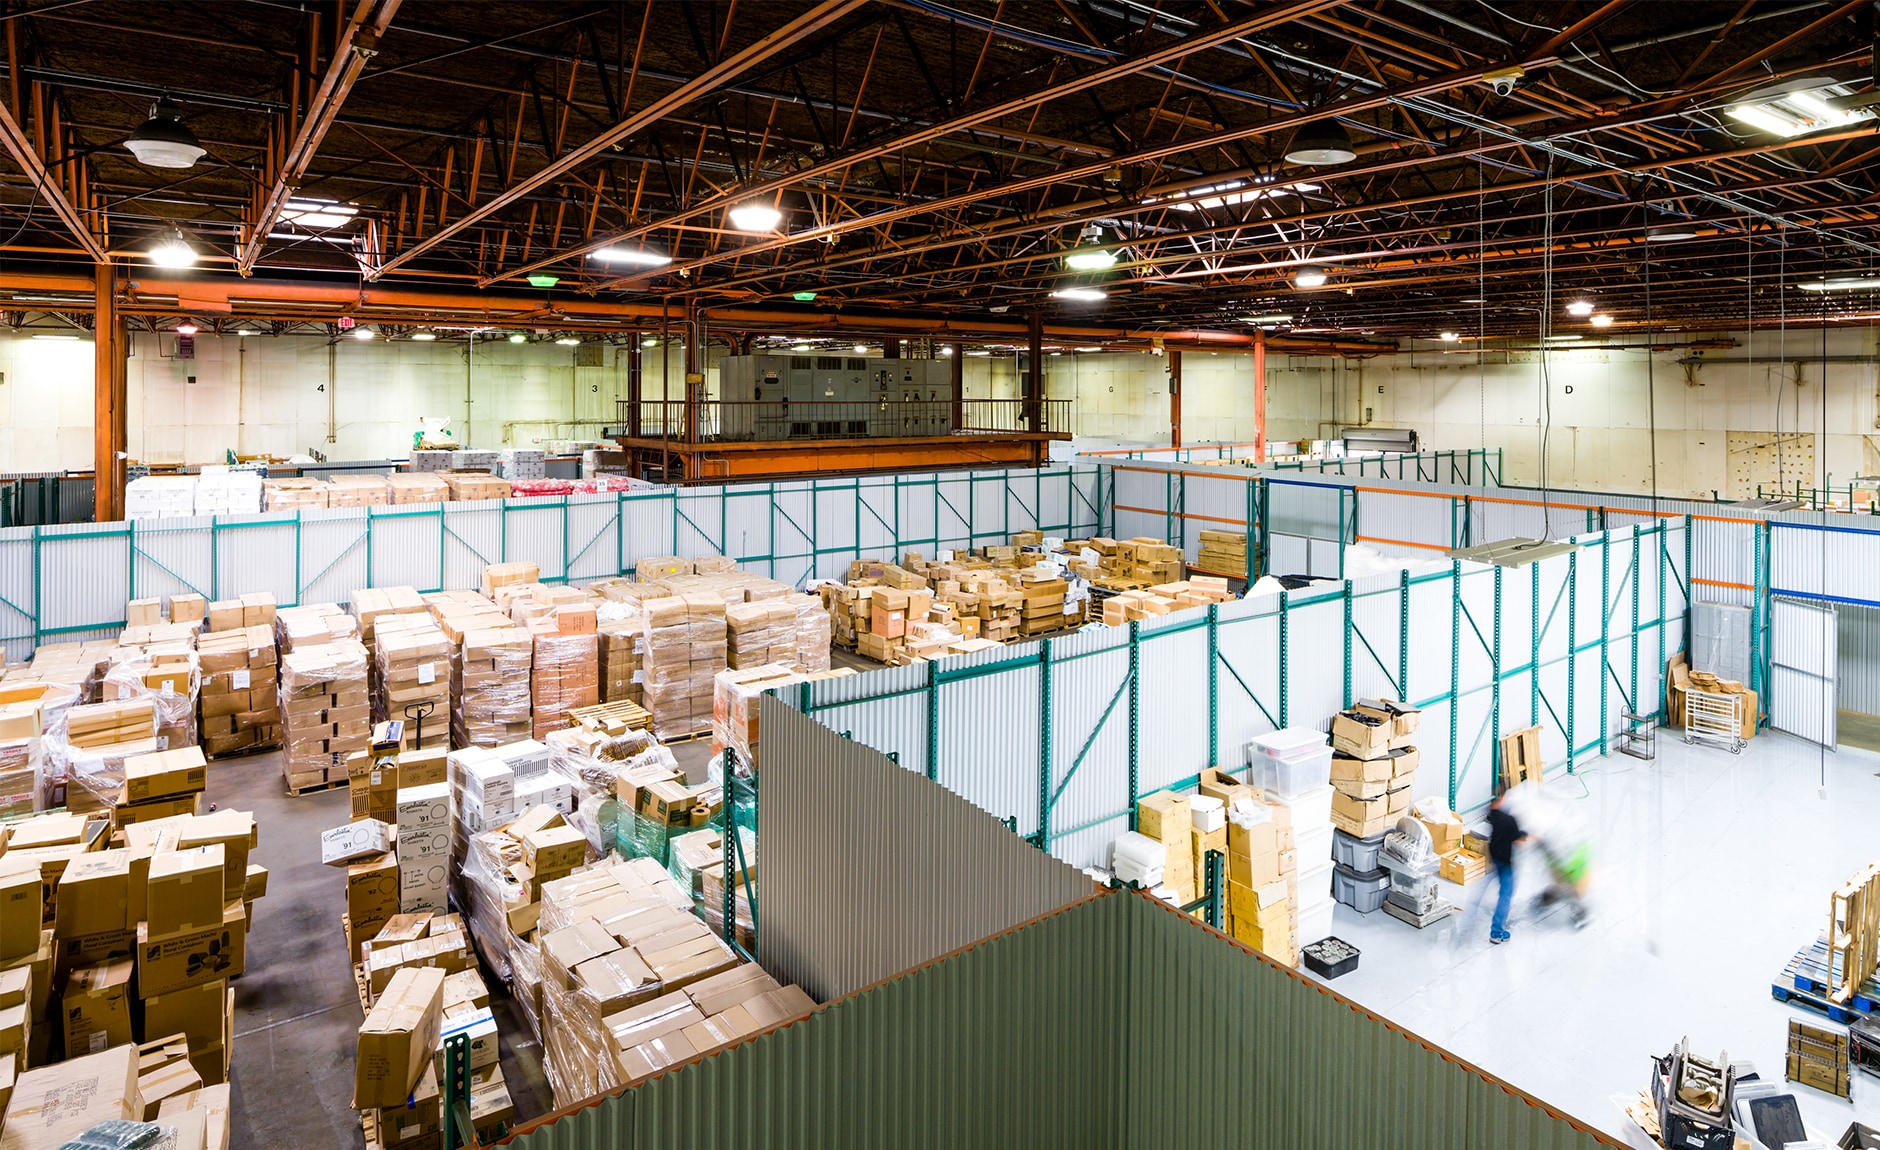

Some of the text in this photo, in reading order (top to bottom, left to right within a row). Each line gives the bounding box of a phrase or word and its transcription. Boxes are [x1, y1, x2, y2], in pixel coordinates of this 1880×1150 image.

[317, 384, 325, 392] 4
[1565, 385, 1573, 394] D
[342, 842, 352, 850] '91
[163, 940, 178, 948] White
[184, 936, 199, 944] Green
[178, 940, 204, 951] Containers
